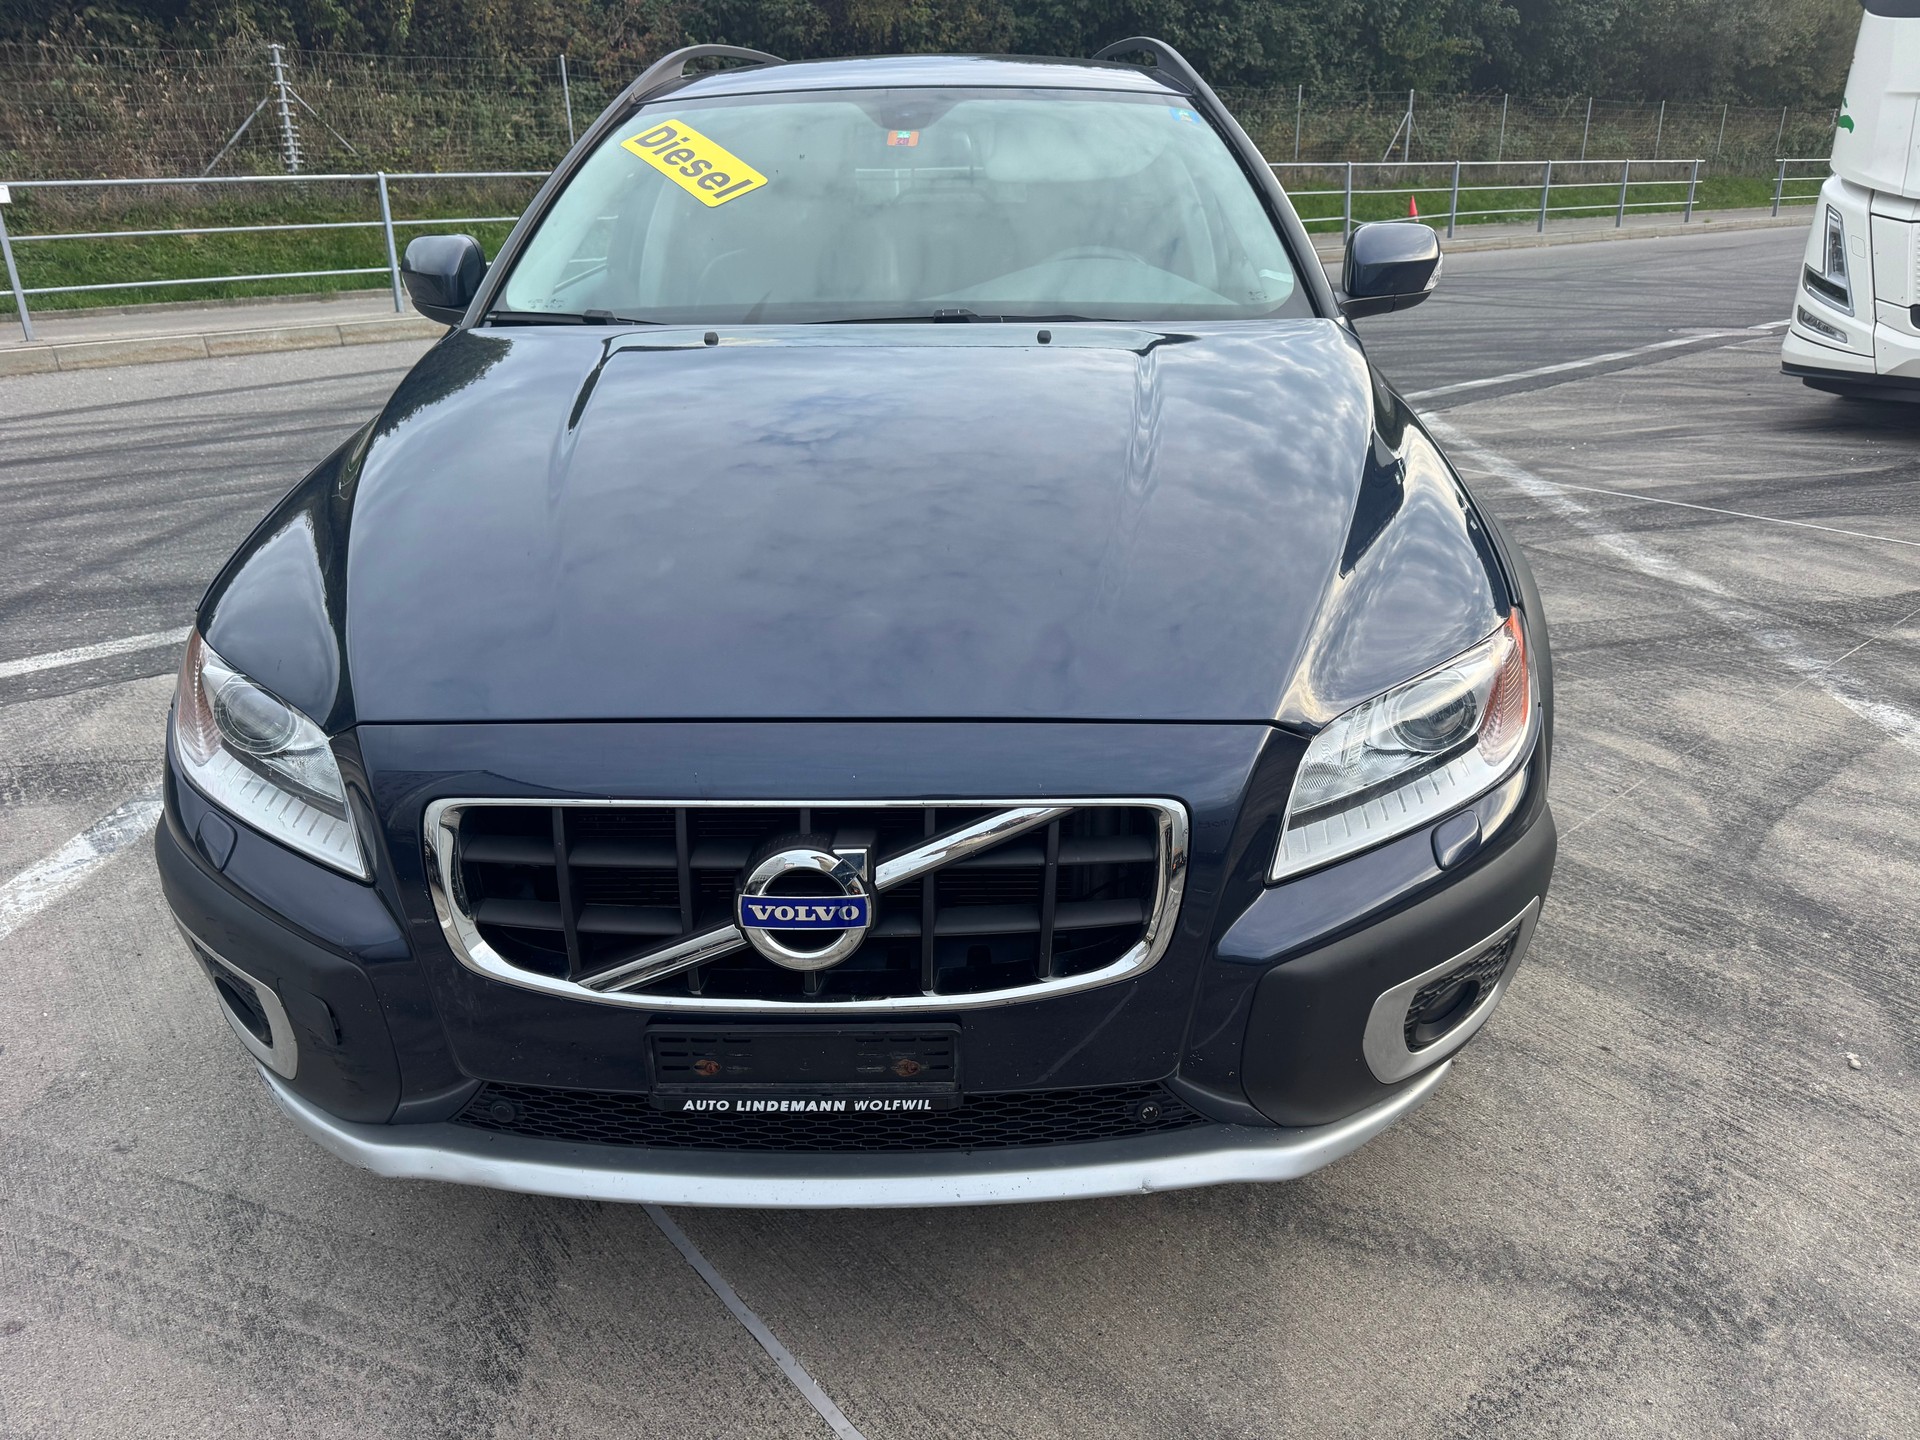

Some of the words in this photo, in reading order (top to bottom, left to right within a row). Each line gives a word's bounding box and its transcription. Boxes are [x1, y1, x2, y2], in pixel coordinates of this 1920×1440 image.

[634, 125, 754, 199] Diesel
[748, 905, 860, 921] VOLVO
[683, 1099, 730, 1112] AUTO
[736, 1099, 846, 1112] LINDEMANN
[854, 1099, 932, 1111] WOLFWIL
